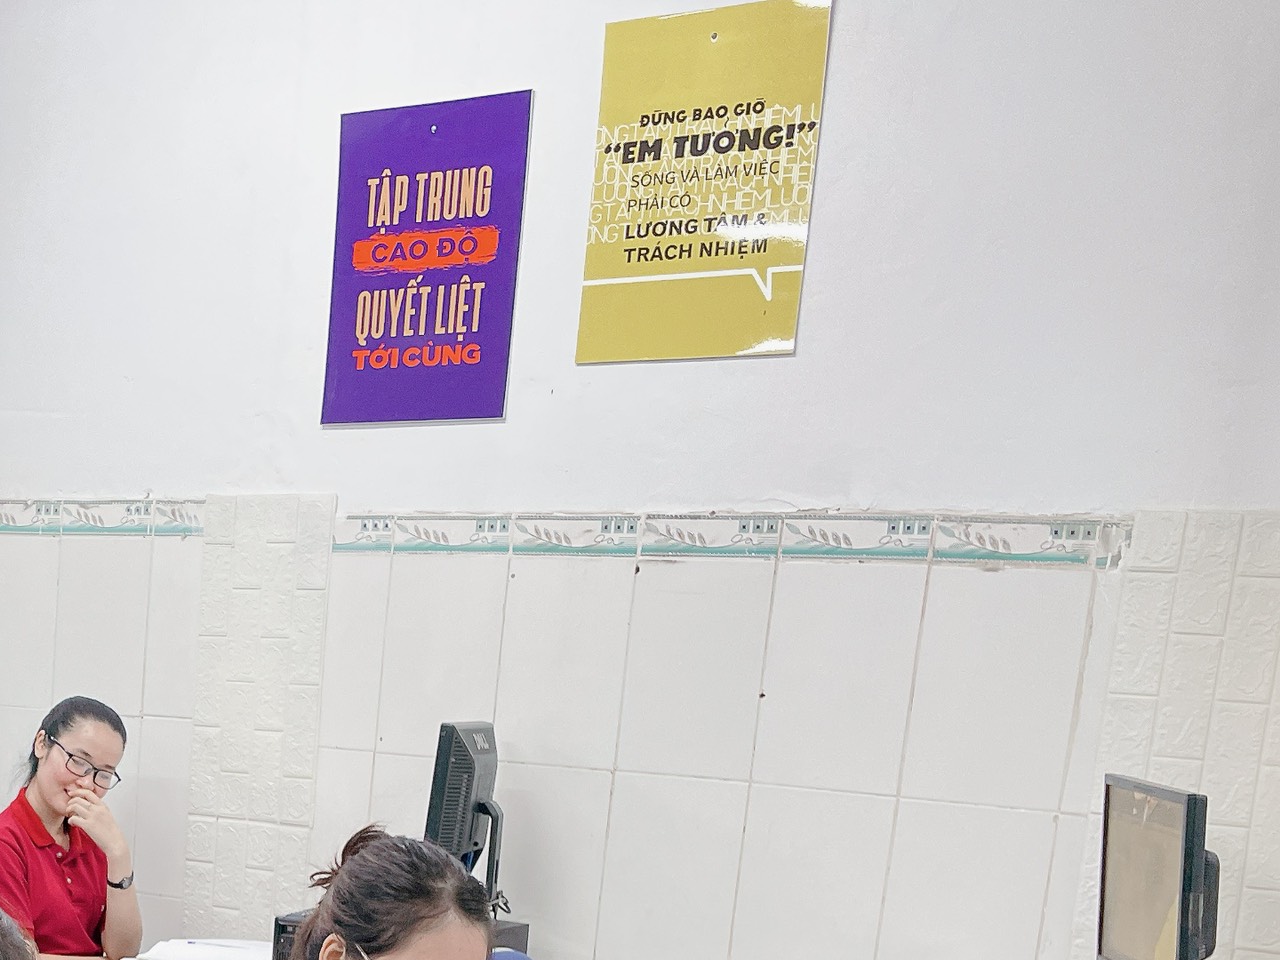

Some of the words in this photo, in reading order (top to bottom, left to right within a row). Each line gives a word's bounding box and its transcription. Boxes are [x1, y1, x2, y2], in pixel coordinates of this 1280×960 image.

[692, 104, 728, 121] BAO
[631, 169, 676, 189] SỐNG
[680, 166, 701, 183] VÀ
[705, 164, 739, 181] LÀM
[743, 158, 780, 179] VIỆC
[367, 168, 409, 235] TẬP
[415, 165, 493, 223] TRUNG
[627, 194, 665, 213] PHẢI
[669, 191, 692, 209] CÓ
[625, 219, 699, 240] LƯƠNG
[704, 211, 748, 233] TÂM
[371, 239, 429, 263] CAO
[436, 229, 478, 262] ĐỘ
[624, 241, 692, 264] TRÁCH
[699, 237, 768, 260] NHIỆM
[355, 275, 432, 346] QUYẾT
[434, 274, 486, 342] LIỆT
[352, 343, 400, 370] TỚI
[402, 340, 481, 367] CÙNG
